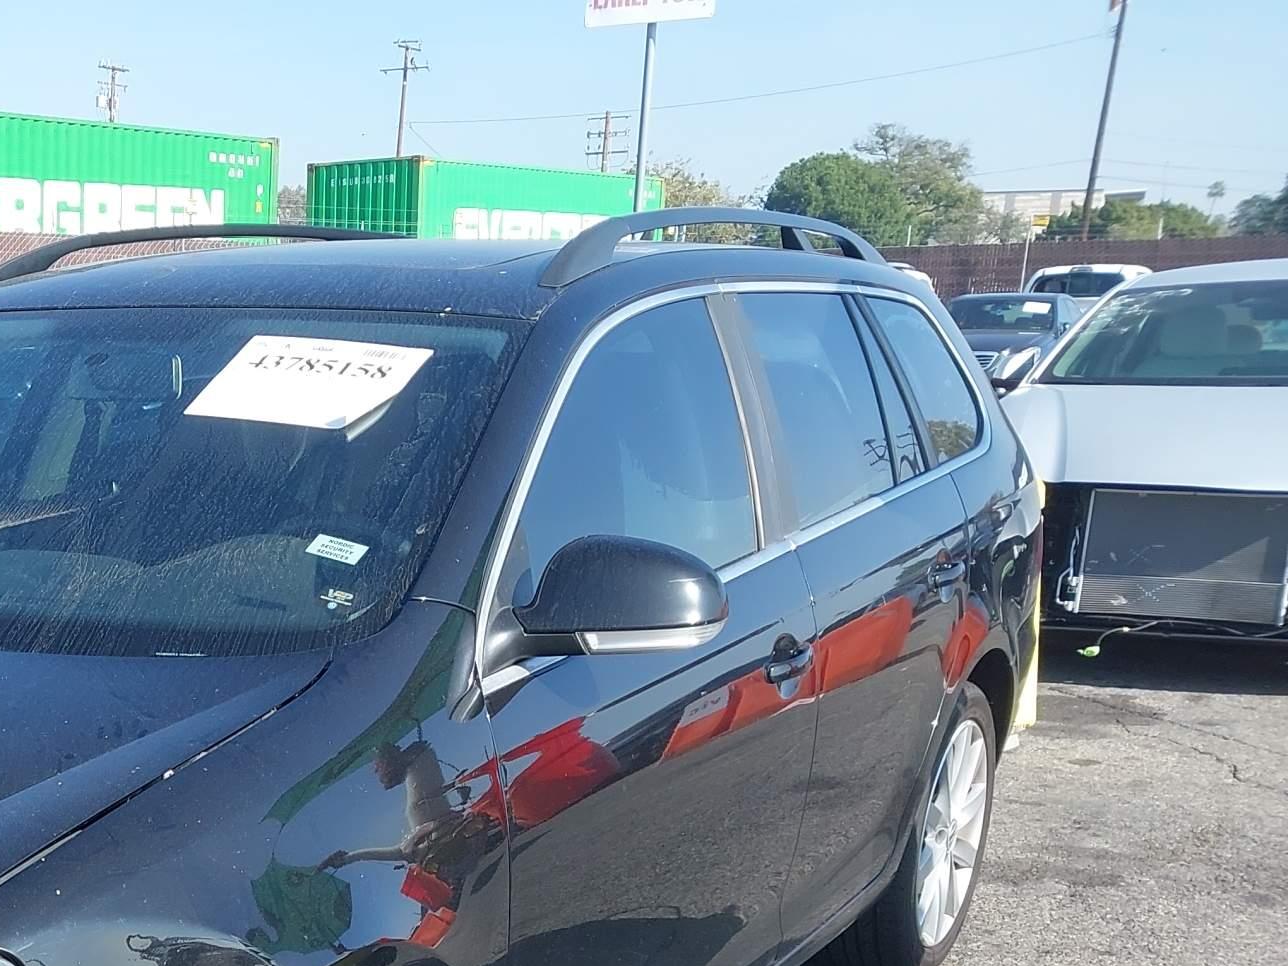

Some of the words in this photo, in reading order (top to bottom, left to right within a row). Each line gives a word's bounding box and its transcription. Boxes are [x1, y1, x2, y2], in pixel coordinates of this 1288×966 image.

[248, 353, 393, 379] 43785158
[320, 543, 354, 556] SECURITY
[328, 538, 356, 550] NORDIC
[316, 548, 349, 561] SERVICES
